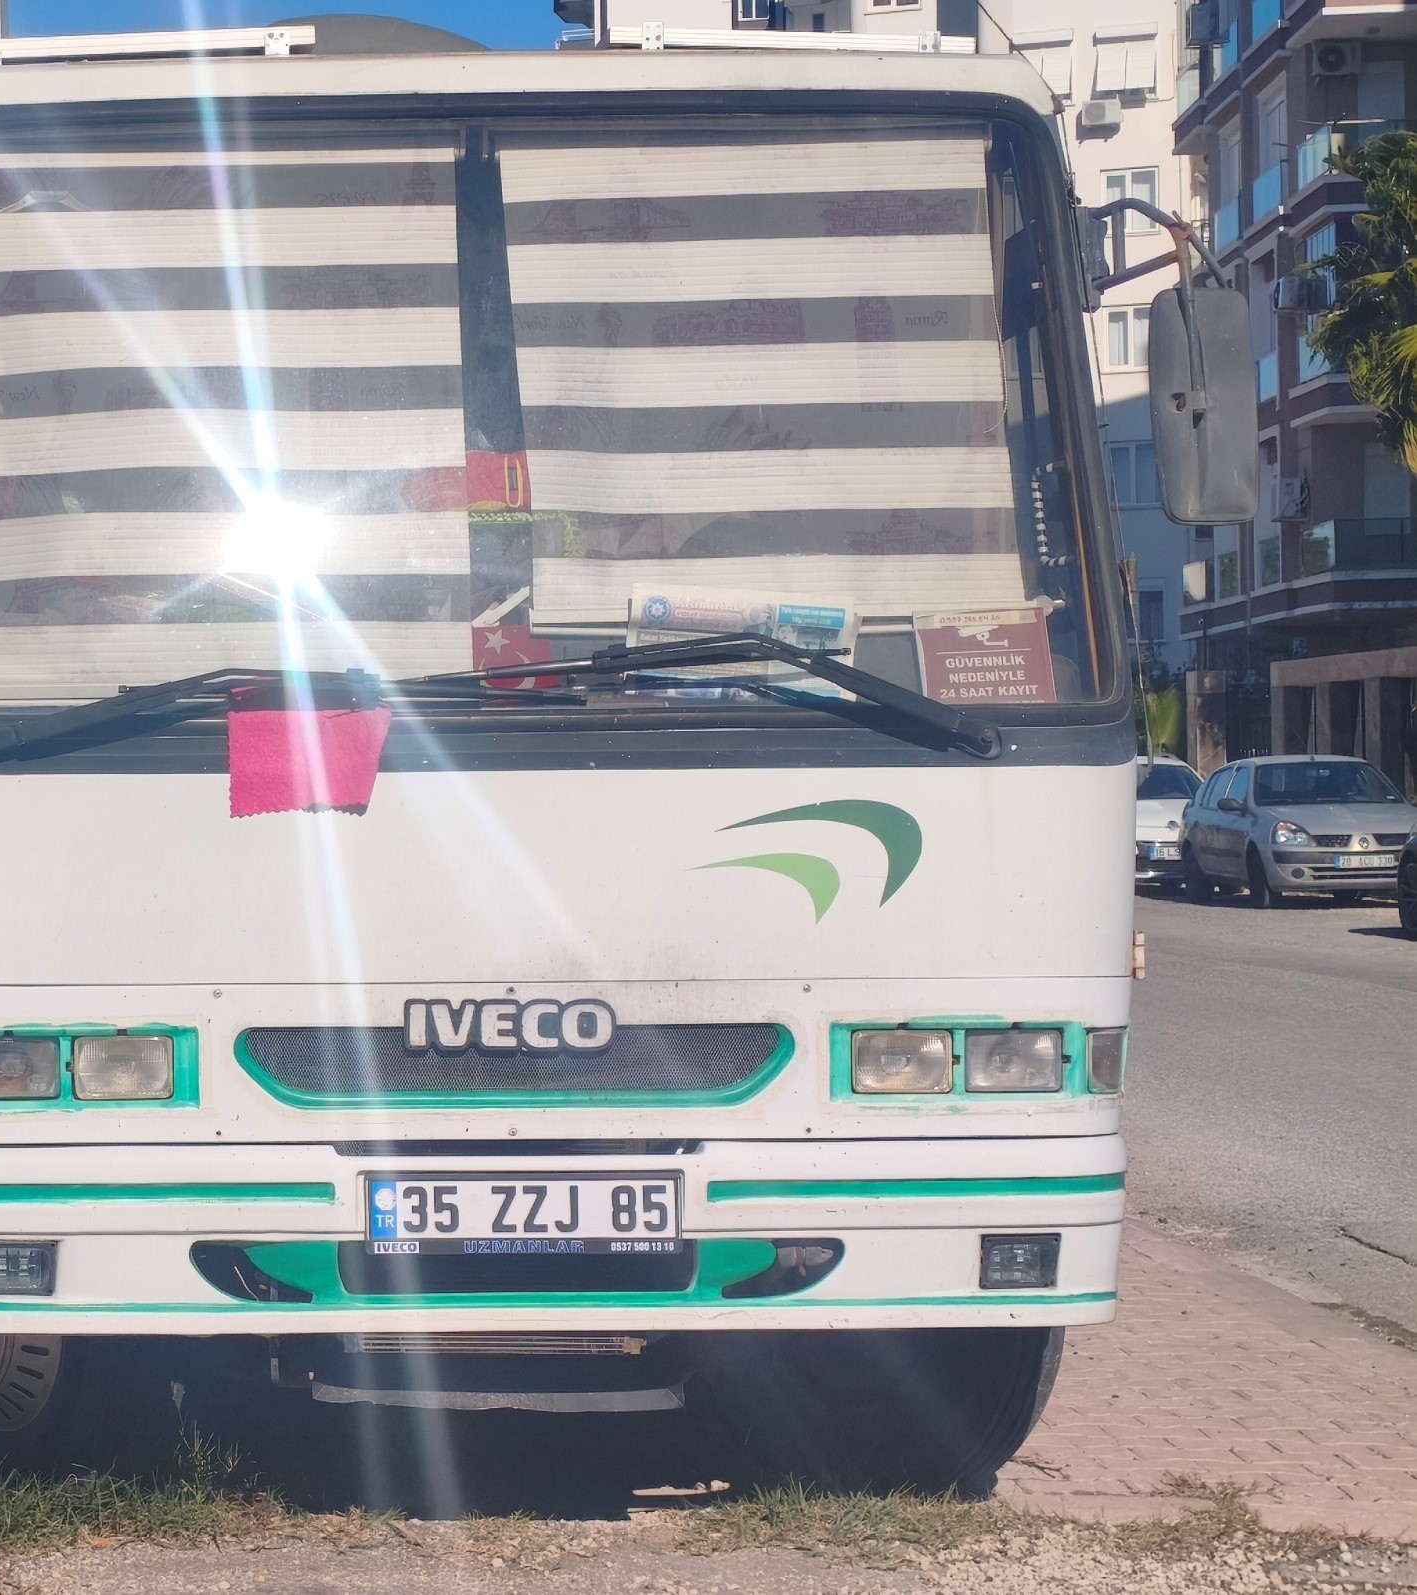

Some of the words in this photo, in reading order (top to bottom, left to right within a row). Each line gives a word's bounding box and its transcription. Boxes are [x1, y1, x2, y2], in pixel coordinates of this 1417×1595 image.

[945, 653, 1026, 669] GÜVENNLİK
[948, 669, 1027, 684] NEDENİYLE
[940, 688, 956, 699] 24
[959, 686, 994, 698] SAAT
[998, 684, 1038, 696] KAYIT
[404, 998, 616, 1050] IVECO
[374, 1214, 395, 1229] TR
[402, 1185, 460, 1233] 35
[490, 1185, 580, 1233] ZZJ
[610, 1184, 669, 1232] 85
[376, 1242, 418, 1253] IVECO
[463, 1239, 585, 1255] UZMANLAR
[610, 1241, 632, 1252] 0537
